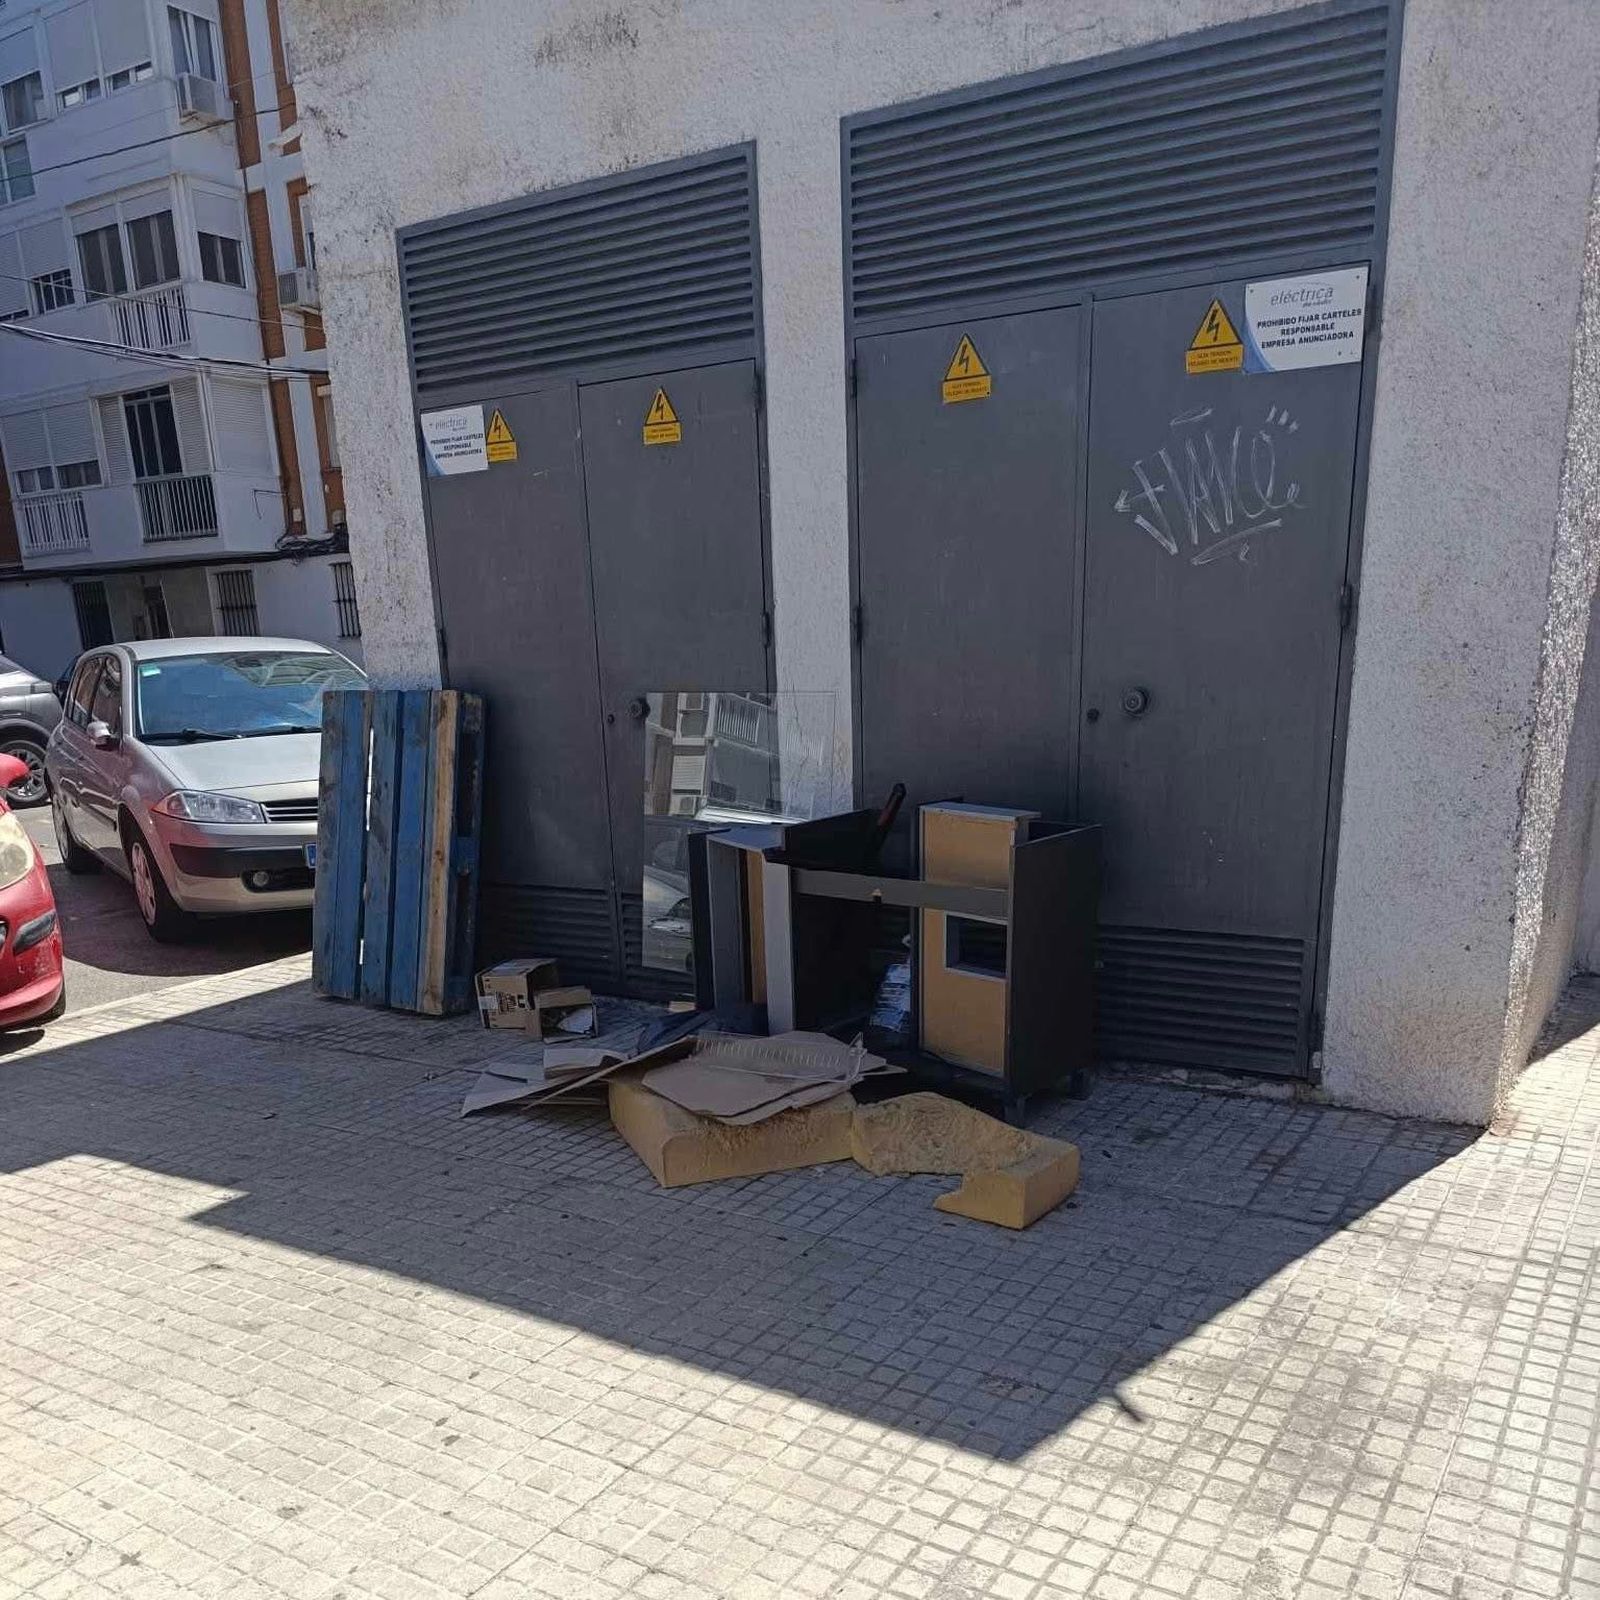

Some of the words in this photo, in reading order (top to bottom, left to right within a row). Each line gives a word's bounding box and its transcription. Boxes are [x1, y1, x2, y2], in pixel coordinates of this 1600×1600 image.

[1270, 287, 1334, 306] eléctrica
[1257, 317, 1297, 329] PROHIBIDO
[1298, 313, 1320, 323] FIJAR
[1321, 308, 1362, 320] CARTELES
[1280, 322, 1335, 336] RESPONSABLE
[1261, 338, 1296, 349] EMPRESA
[1298, 331, 1354, 344] ANUNCIADORA
